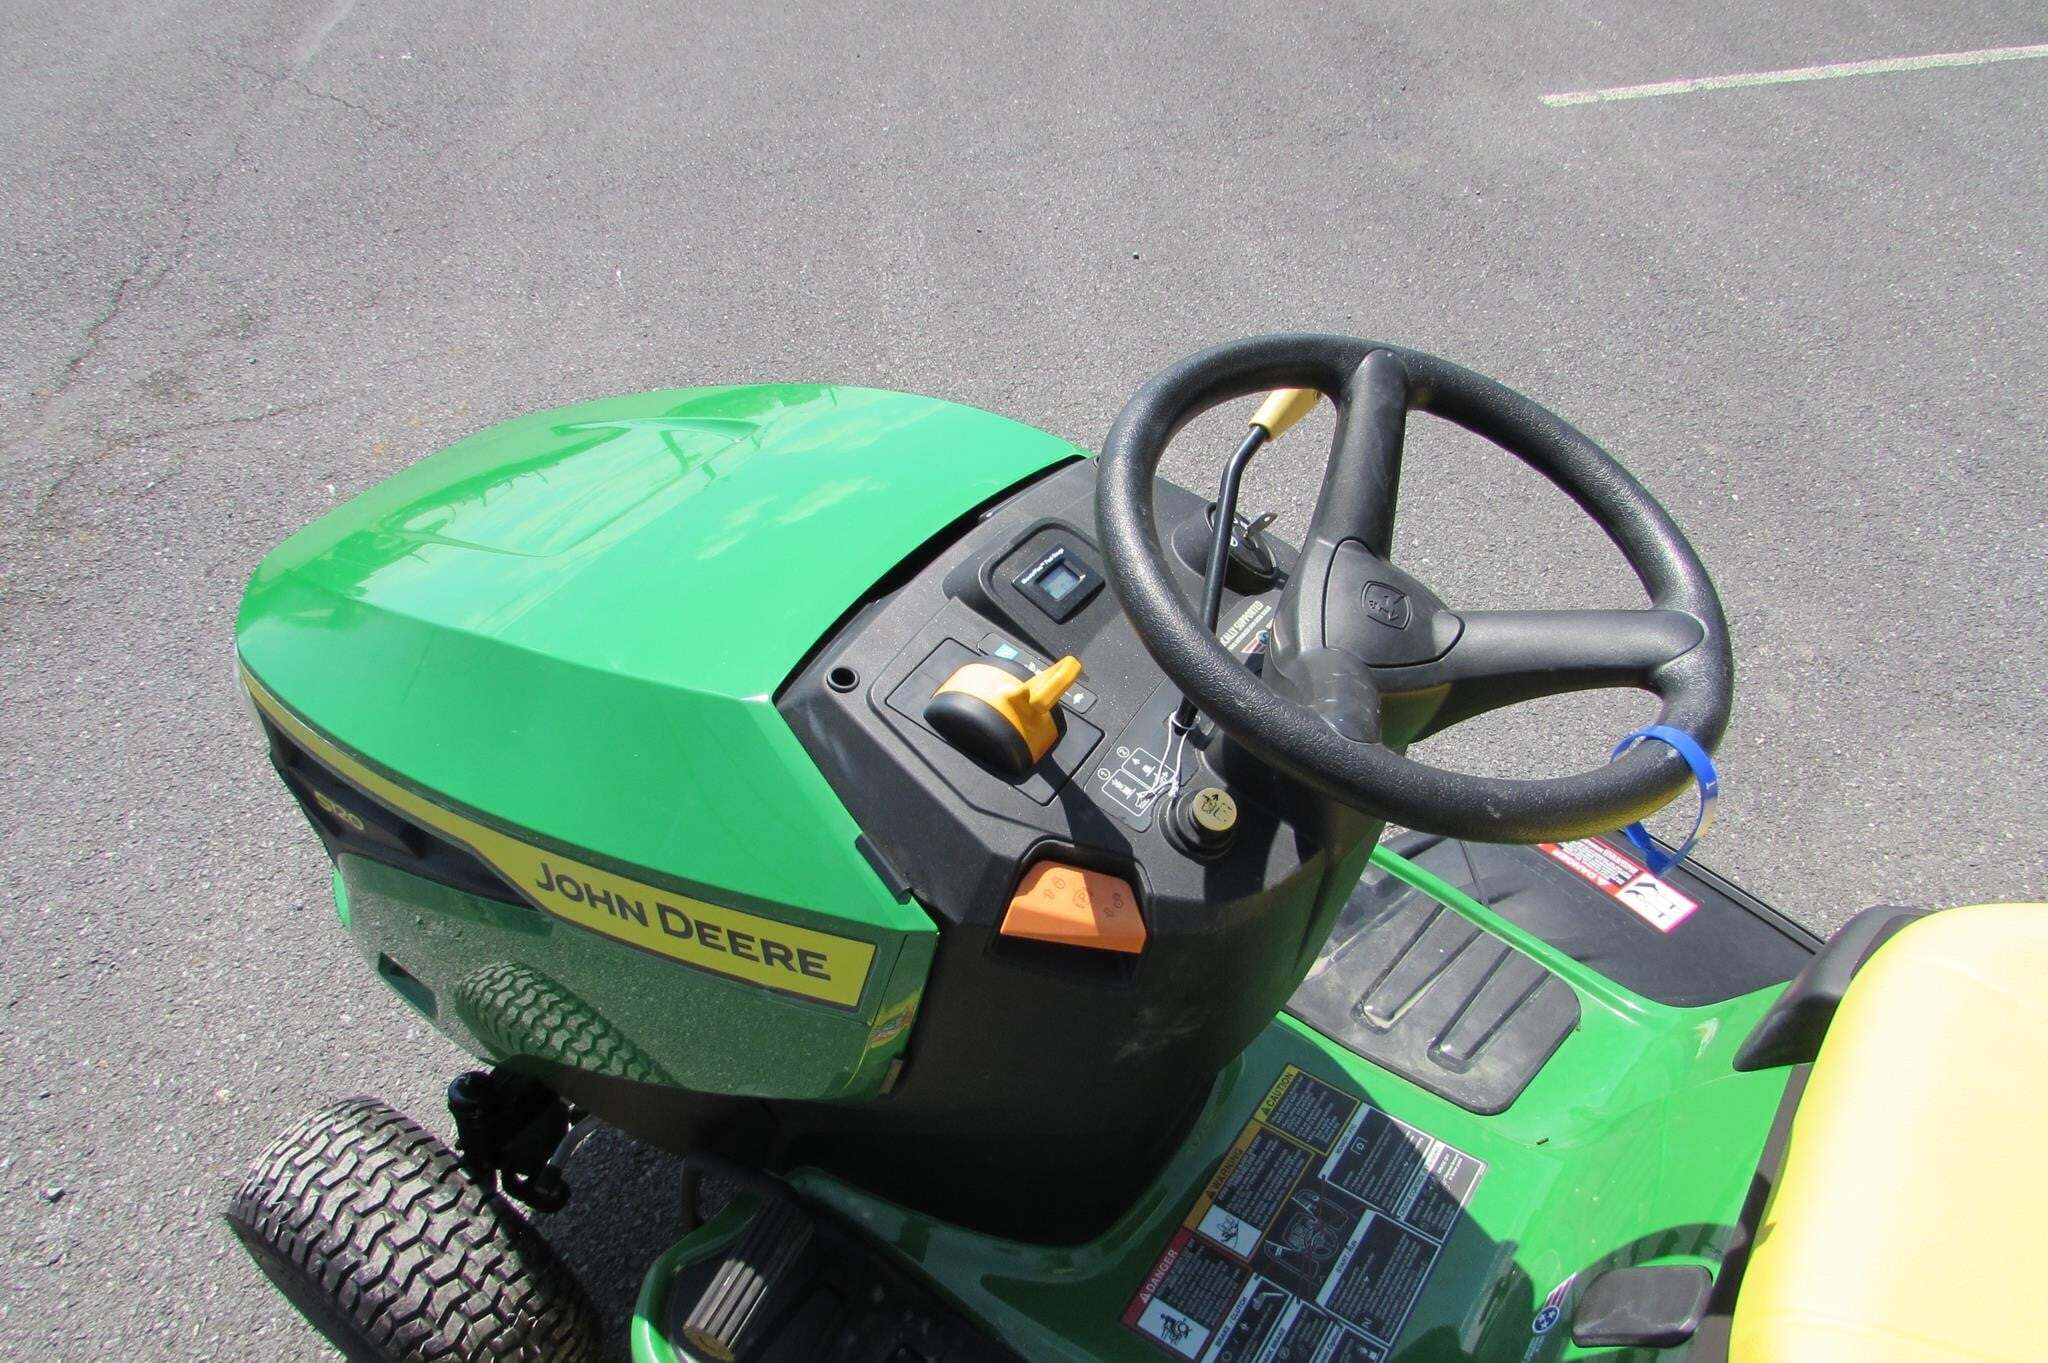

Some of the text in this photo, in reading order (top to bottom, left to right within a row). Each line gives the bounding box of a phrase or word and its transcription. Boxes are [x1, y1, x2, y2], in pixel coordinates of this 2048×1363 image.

[536, 862, 832, 982] JOHN DEERE
[1268, 1072, 1294, 1108] CAUTION
[1213, 1149, 1243, 1191] WARNING
[1145, 1248, 1178, 1292] DANGER
[1214, 1325, 1230, 1346] BRAKE
[1230, 1296, 1247, 1319] CLUTCH
